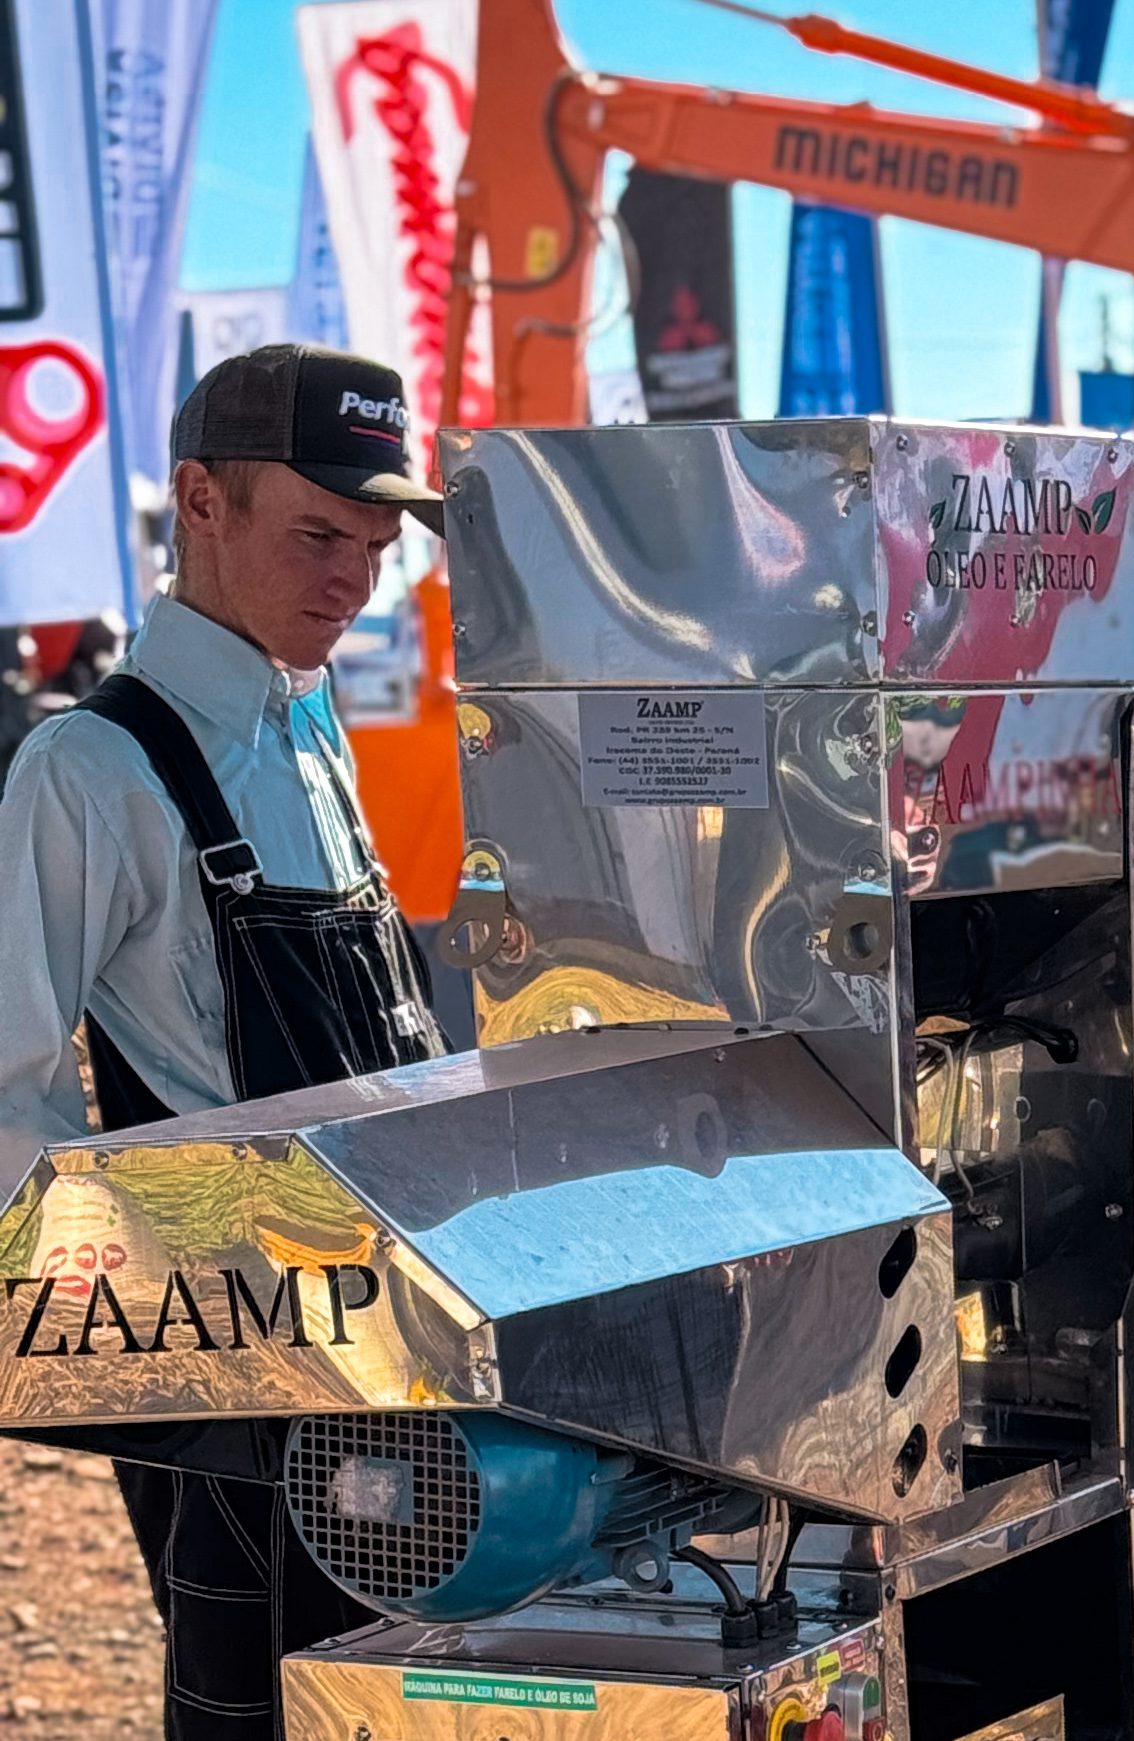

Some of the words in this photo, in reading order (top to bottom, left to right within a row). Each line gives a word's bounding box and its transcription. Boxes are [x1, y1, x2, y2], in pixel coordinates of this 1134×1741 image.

[774, 126, 1018, 209] MICHIGAN
[952, 474, 1073, 536] ZAAMP
[994, 552, 1008, 590] E
[1013, 552, 1097, 591] FARELO
[637, 698, 702, 718] ZAAMP
[5, 1264, 381, 1358] ZAAMP
[443, 1682, 465, 1696] PARA
[467, 1684, 493, 1698] FAZER
[493, 1686, 526, 1701] FARELO
[527, 1689, 533, 1702] E
[559, 1691, 571, 1704] DE
[572, 1692, 595, 1705] SOJA
